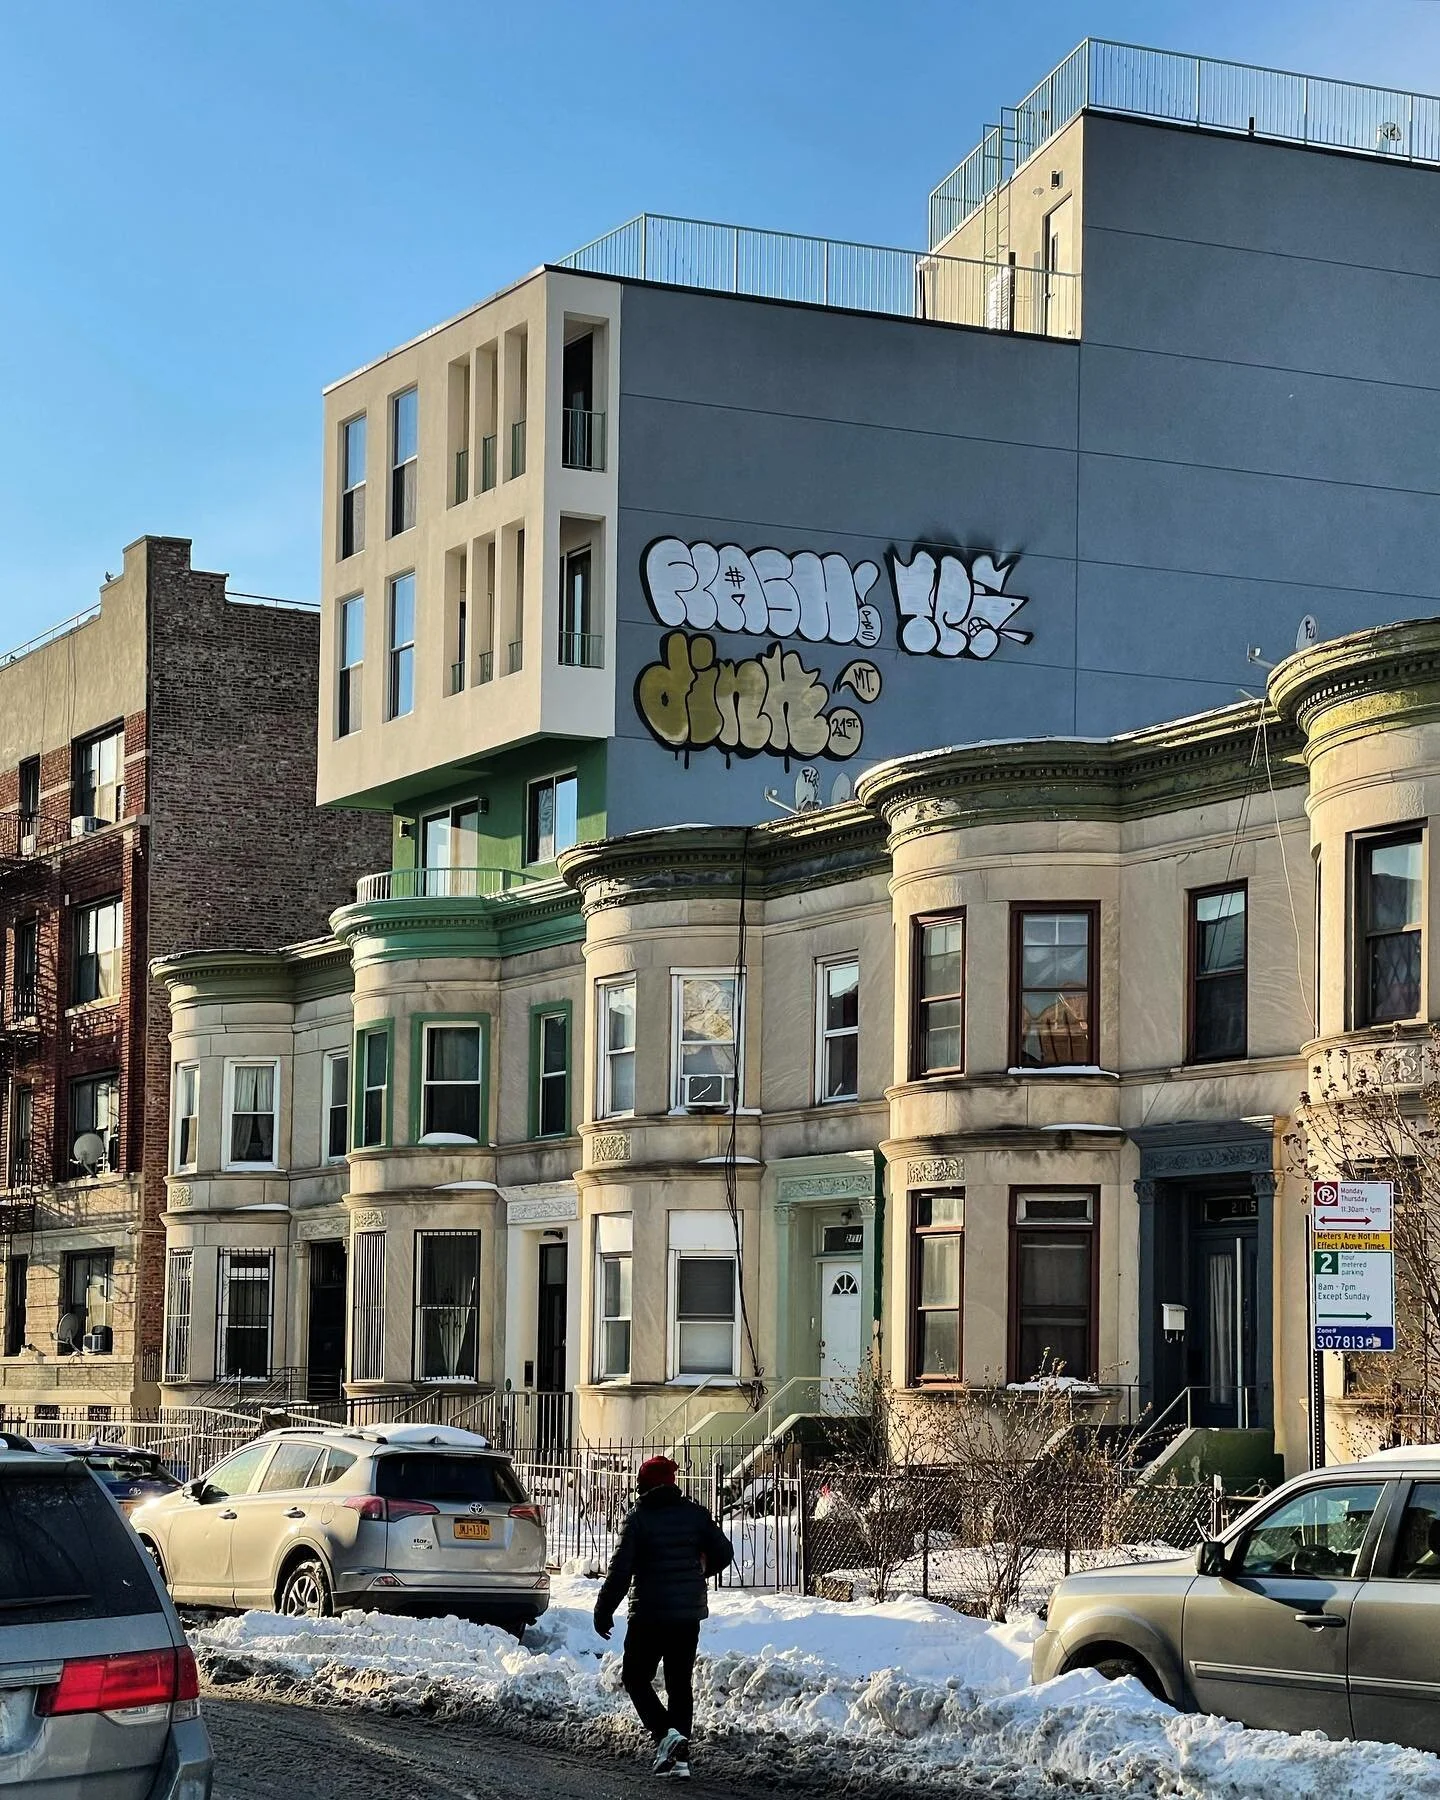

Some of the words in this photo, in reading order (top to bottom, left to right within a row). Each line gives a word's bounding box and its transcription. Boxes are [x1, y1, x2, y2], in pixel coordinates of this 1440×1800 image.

[1341, 1187, 1363, 1195] Monday
[1341, 1195, 1368, 1203] Thursday
[1317, 1242, 1338, 1250] Effect
[1340, 1242, 1363, 1250] Above
[1365, 1242, 1385, 1250] Times
[1320, 1253, 1333, 1273] 2
[1341, 1283, 1356, 1291] 7pm
[1317, 1292, 1342, 1300] Except
[1344, 1292, 1370, 1301] Sunday
[1317, 1336, 1364, 1348] 307813
